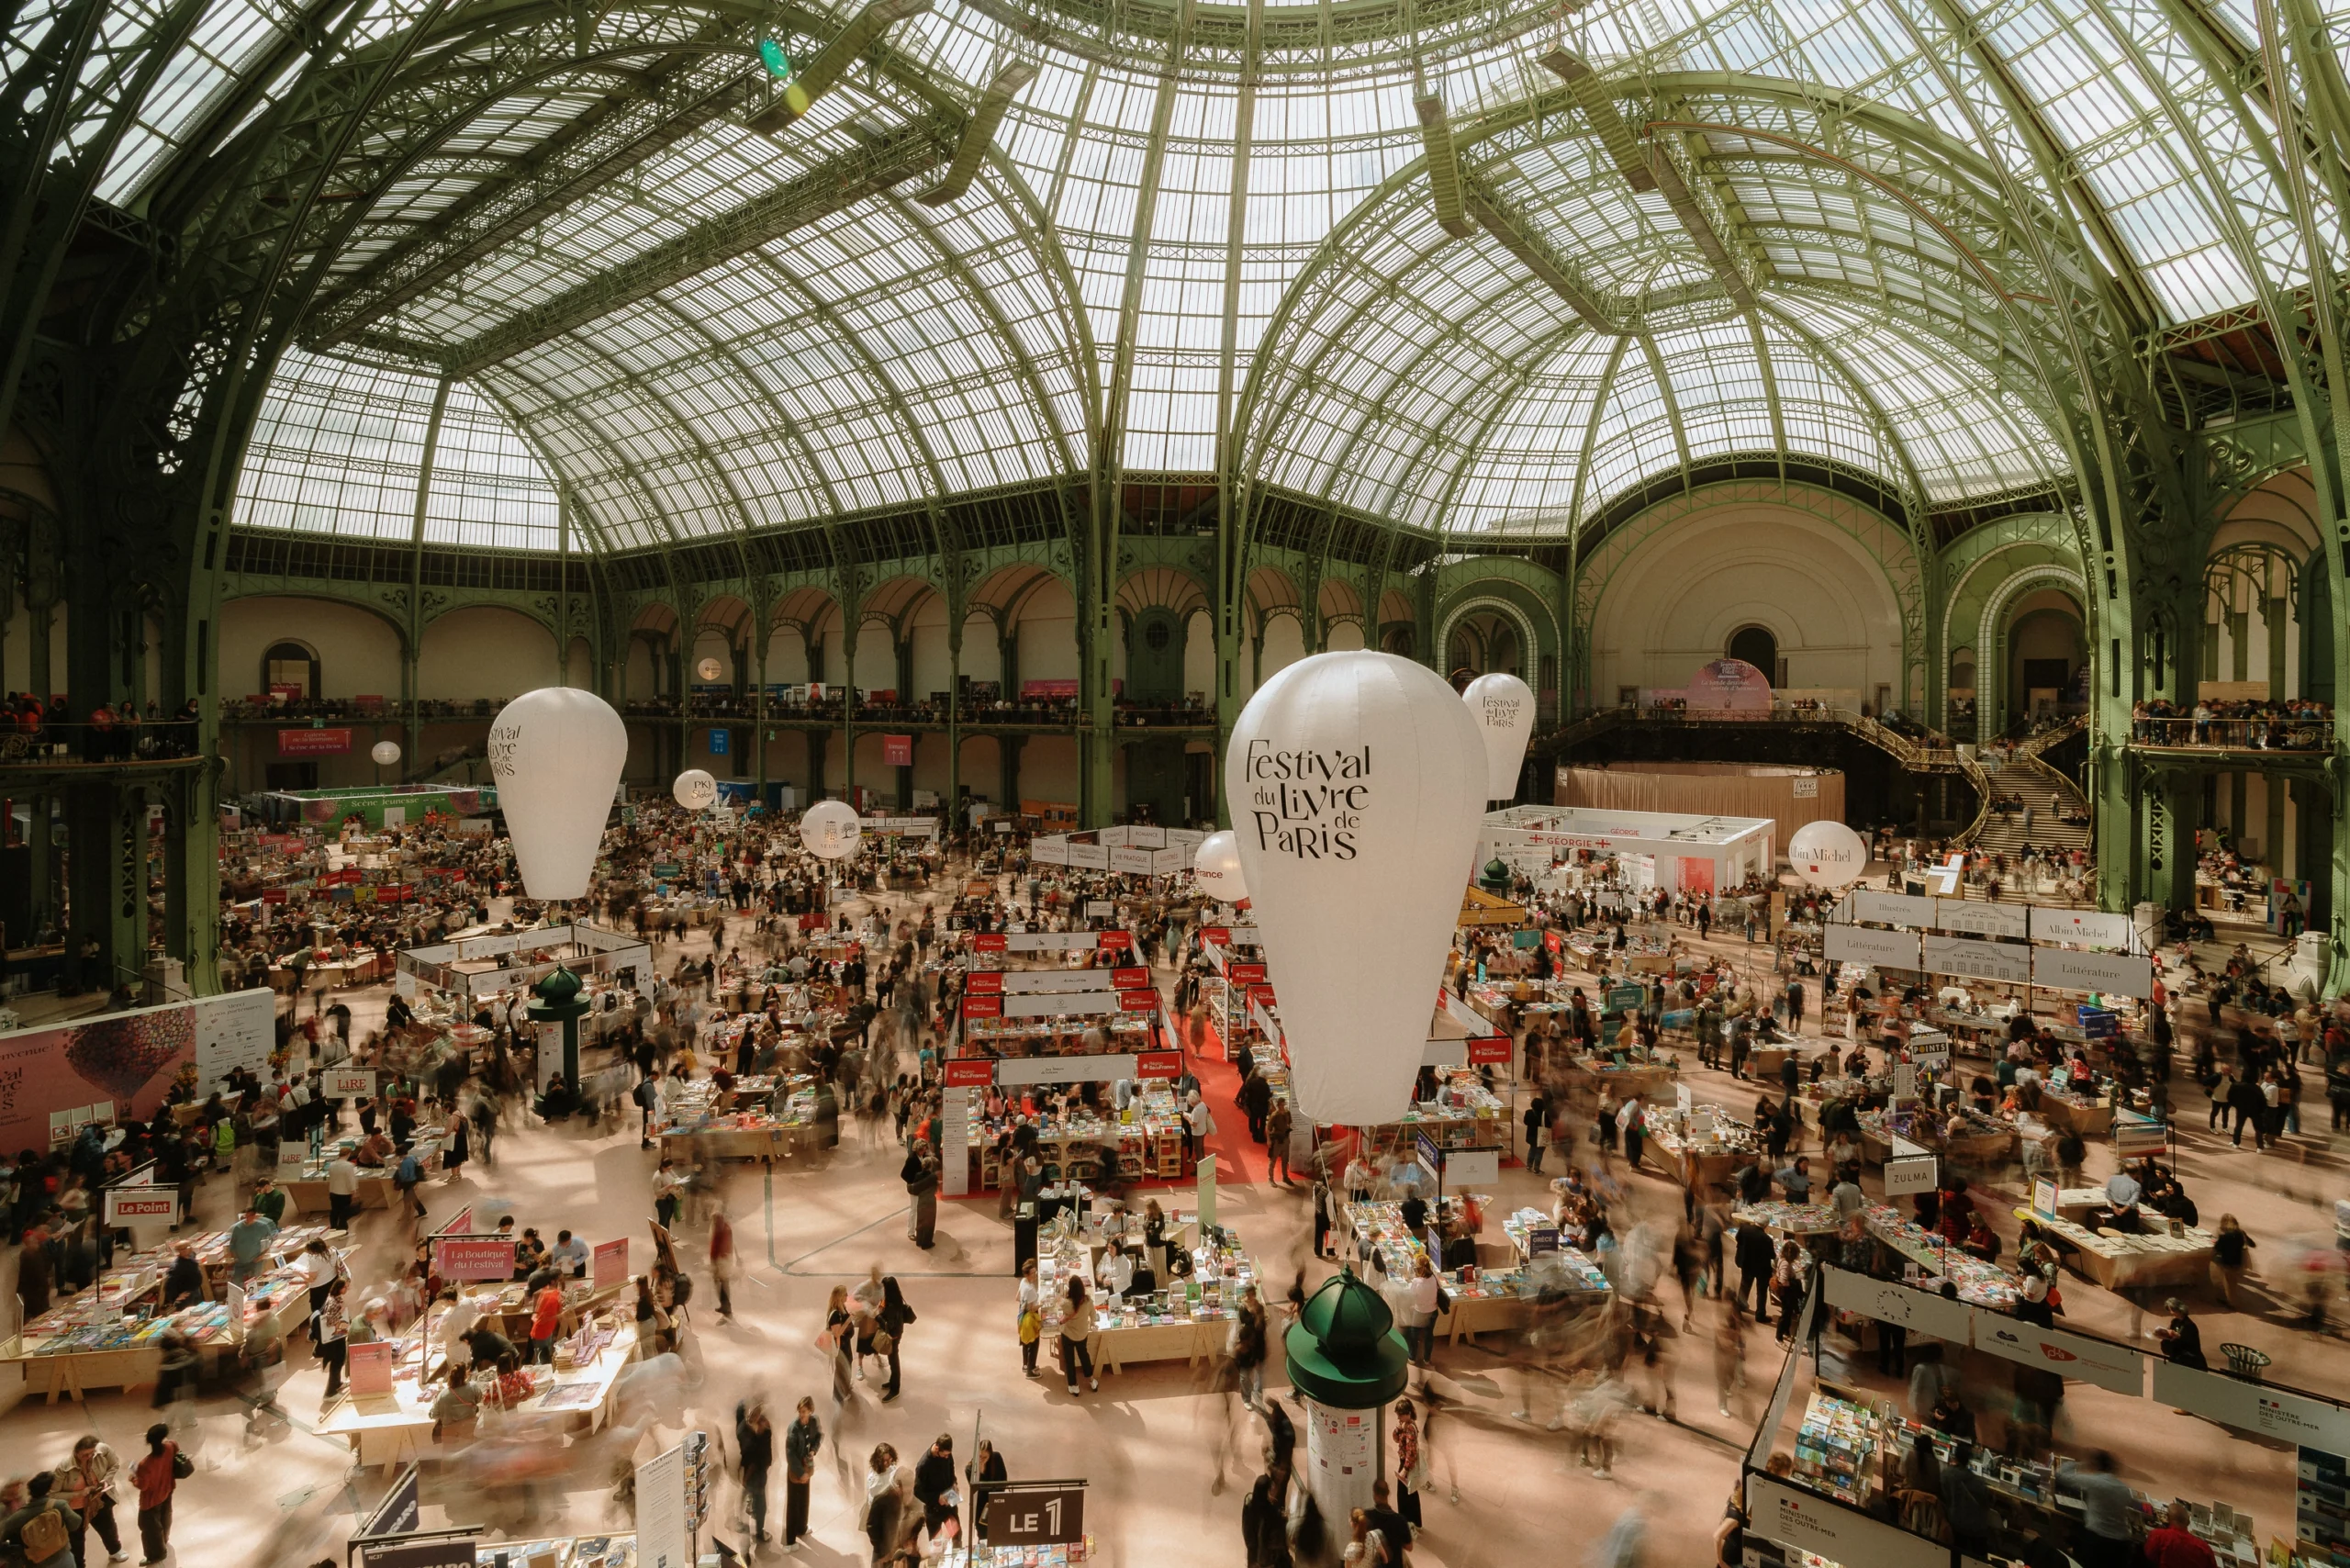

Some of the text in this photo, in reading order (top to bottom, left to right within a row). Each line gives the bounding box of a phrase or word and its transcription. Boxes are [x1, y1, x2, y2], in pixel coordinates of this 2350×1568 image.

[1483, 696, 1520, 709] Festival
[503, 754, 512, 762] de
[1247, 740, 1370, 782] Festival
[1254, 786, 1275, 806] du
[351, 799, 378, 808] Scène
[382, 797, 419, 806] Jeunesse
[1335, 811, 1360, 828] de
[1135, 830, 1158, 839] ROMANCE
[1610, 826, 1639, 836] GÉORGIE
[1546, 836, 1593, 848] GÉORGIE
[1048, 846, 1065, 854] FICTION
[1812, 848, 1851, 862] Michel
[1123, 855, 1147, 863] PRATIQUE
[1196, 868, 1223, 879] France
[1878, 903, 1911, 913] Illustrés
[2047, 924, 2108, 938] Albin Michel
[1549, 938, 1557, 947] puf
[1847, 939, 1895, 953] Littérature
[2062, 964, 2121, 980] Littérature
[228, 1004, 263, 1014] partenaires
[2, 1099, 15, 1110] S
[1894, 1171, 1928, 1183] ZULMA
[120, 1203, 168, 1214] Le Point
[452, 1250, 507, 1259] La Boutique
[454, 1260, 504, 1269] du Festival
[2259, 1406, 2300, 1420] MINISTÈRE
[2259, 1411, 2320, 1431] DES OUTRE-MER
[648, 1460, 673, 1474] RENCONTRES
[1010, 1497, 1061, 1535] LE 1
[1780, 1506, 1818, 1524] MINISTÈRE
[1780, 1513, 1837, 1539] DES OUTRE-MER
